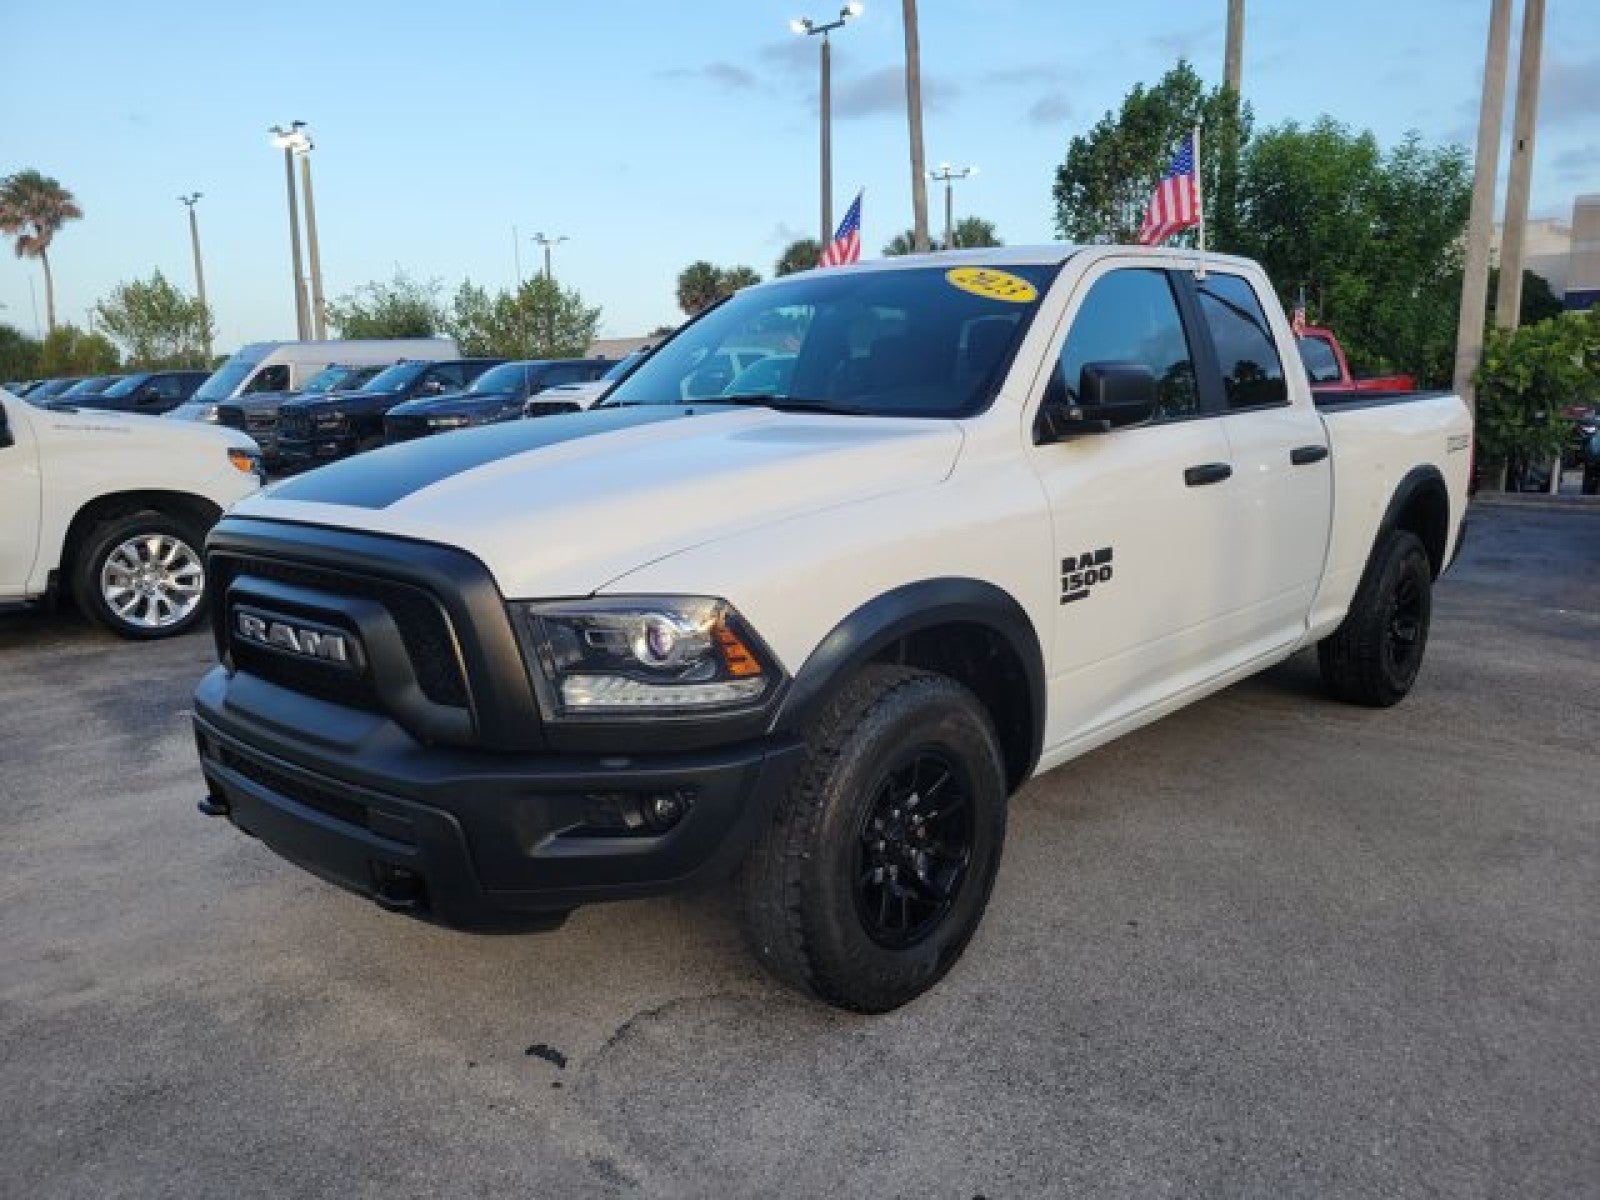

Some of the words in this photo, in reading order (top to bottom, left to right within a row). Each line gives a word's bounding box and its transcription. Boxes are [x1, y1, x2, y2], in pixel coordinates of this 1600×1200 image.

[1061, 546, 1113, 574] RAM
[1061, 565, 1113, 593] 1500
[239, 612, 346, 661] RAM
